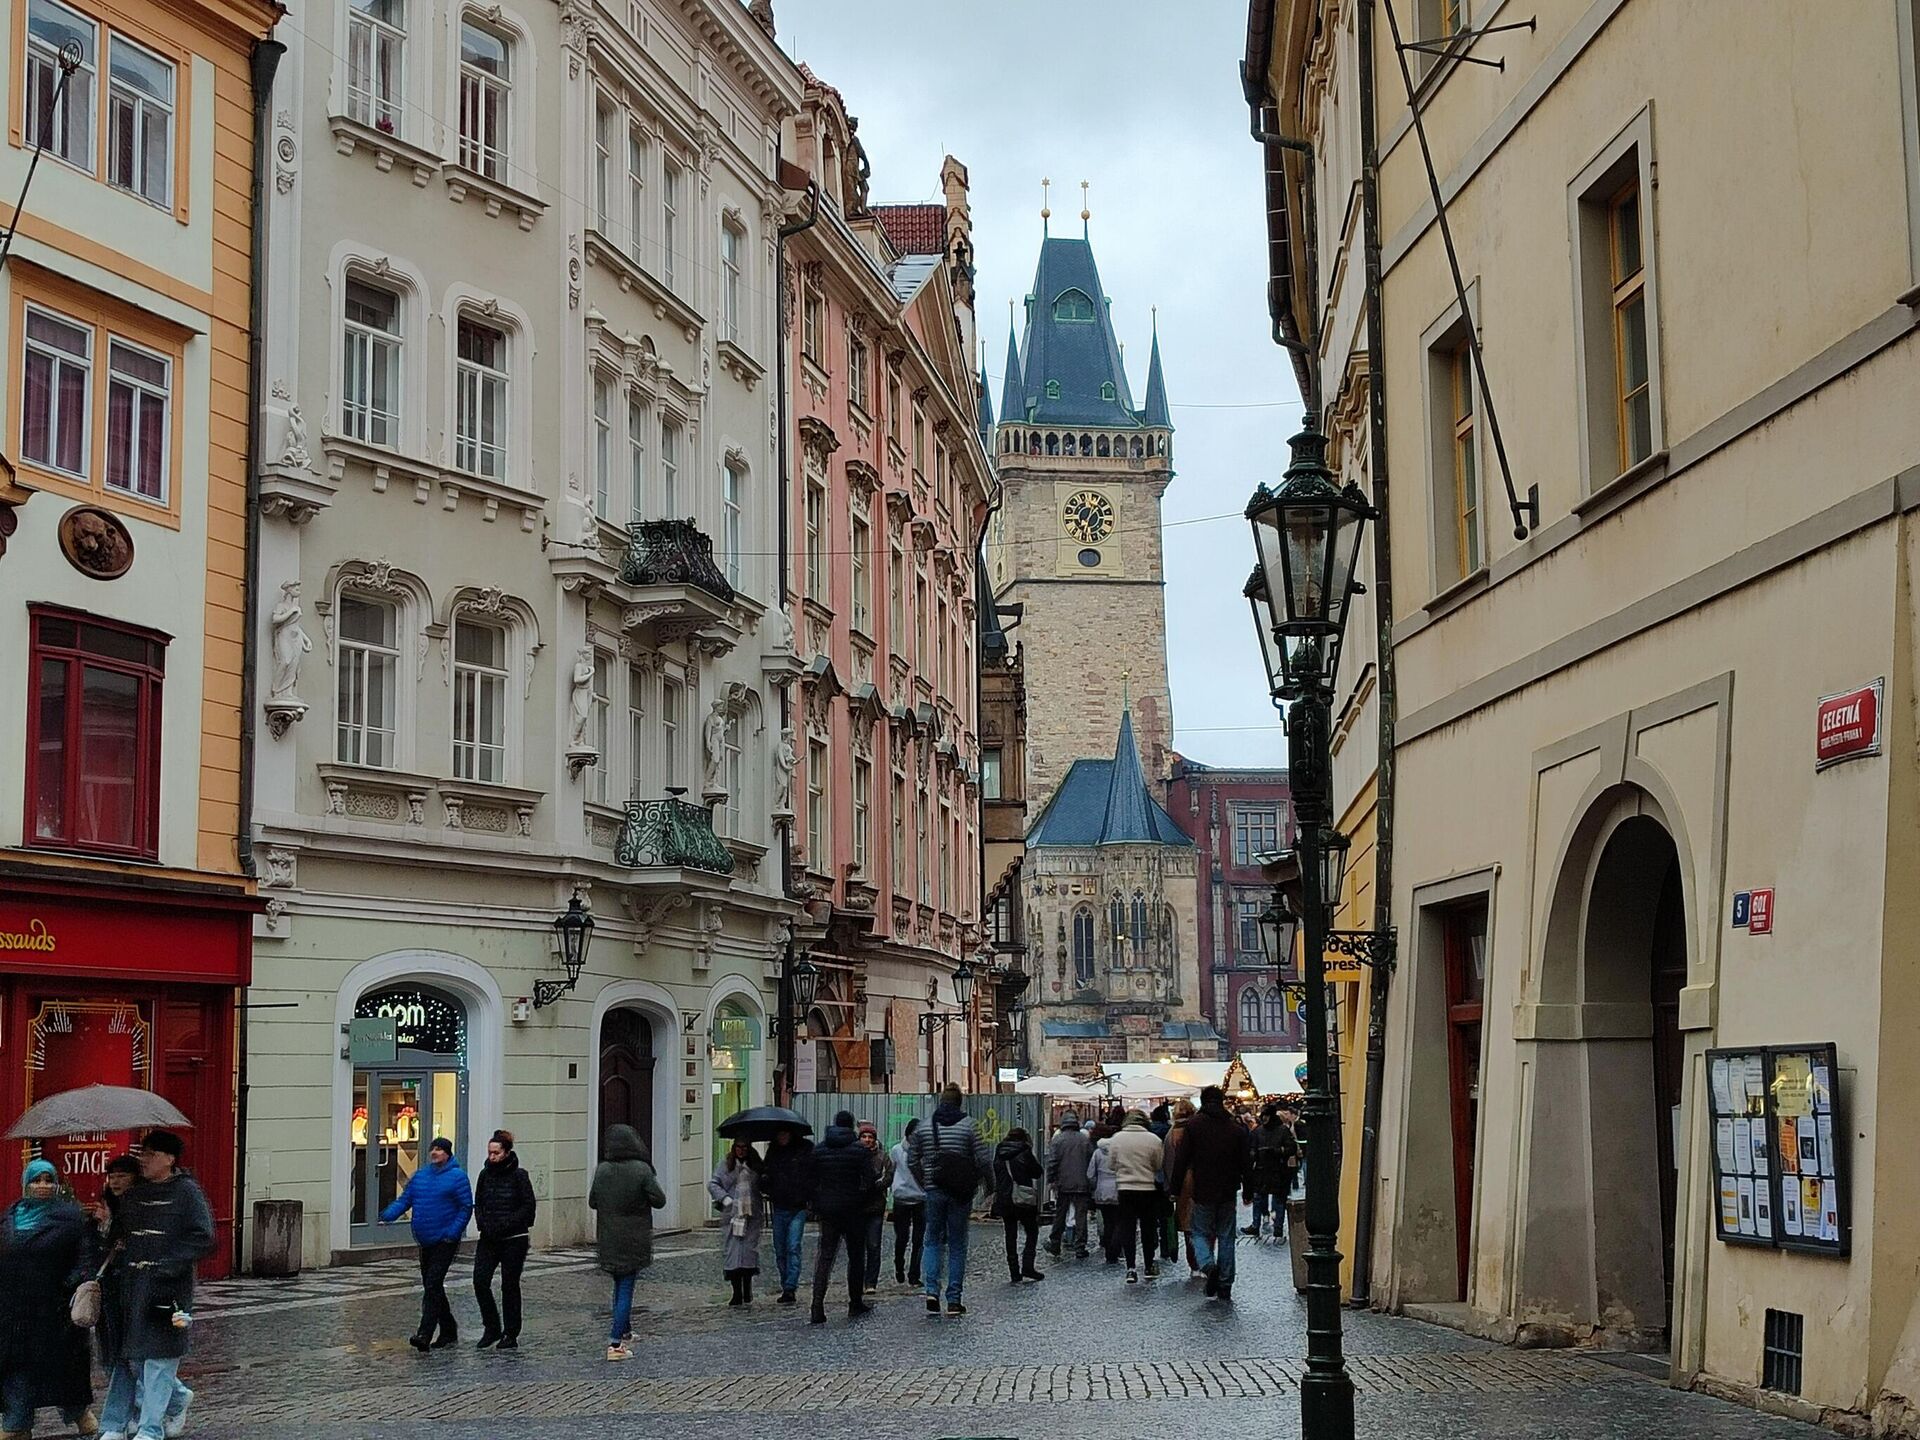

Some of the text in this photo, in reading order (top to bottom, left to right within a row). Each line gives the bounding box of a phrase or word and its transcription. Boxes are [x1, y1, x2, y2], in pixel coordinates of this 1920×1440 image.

[1822, 698, 1862, 733] CELETNÁ
[1736, 900, 1743, 918] 5
[1752, 895, 1767, 914] 601
[62, 1150, 111, 1175] STAGE
